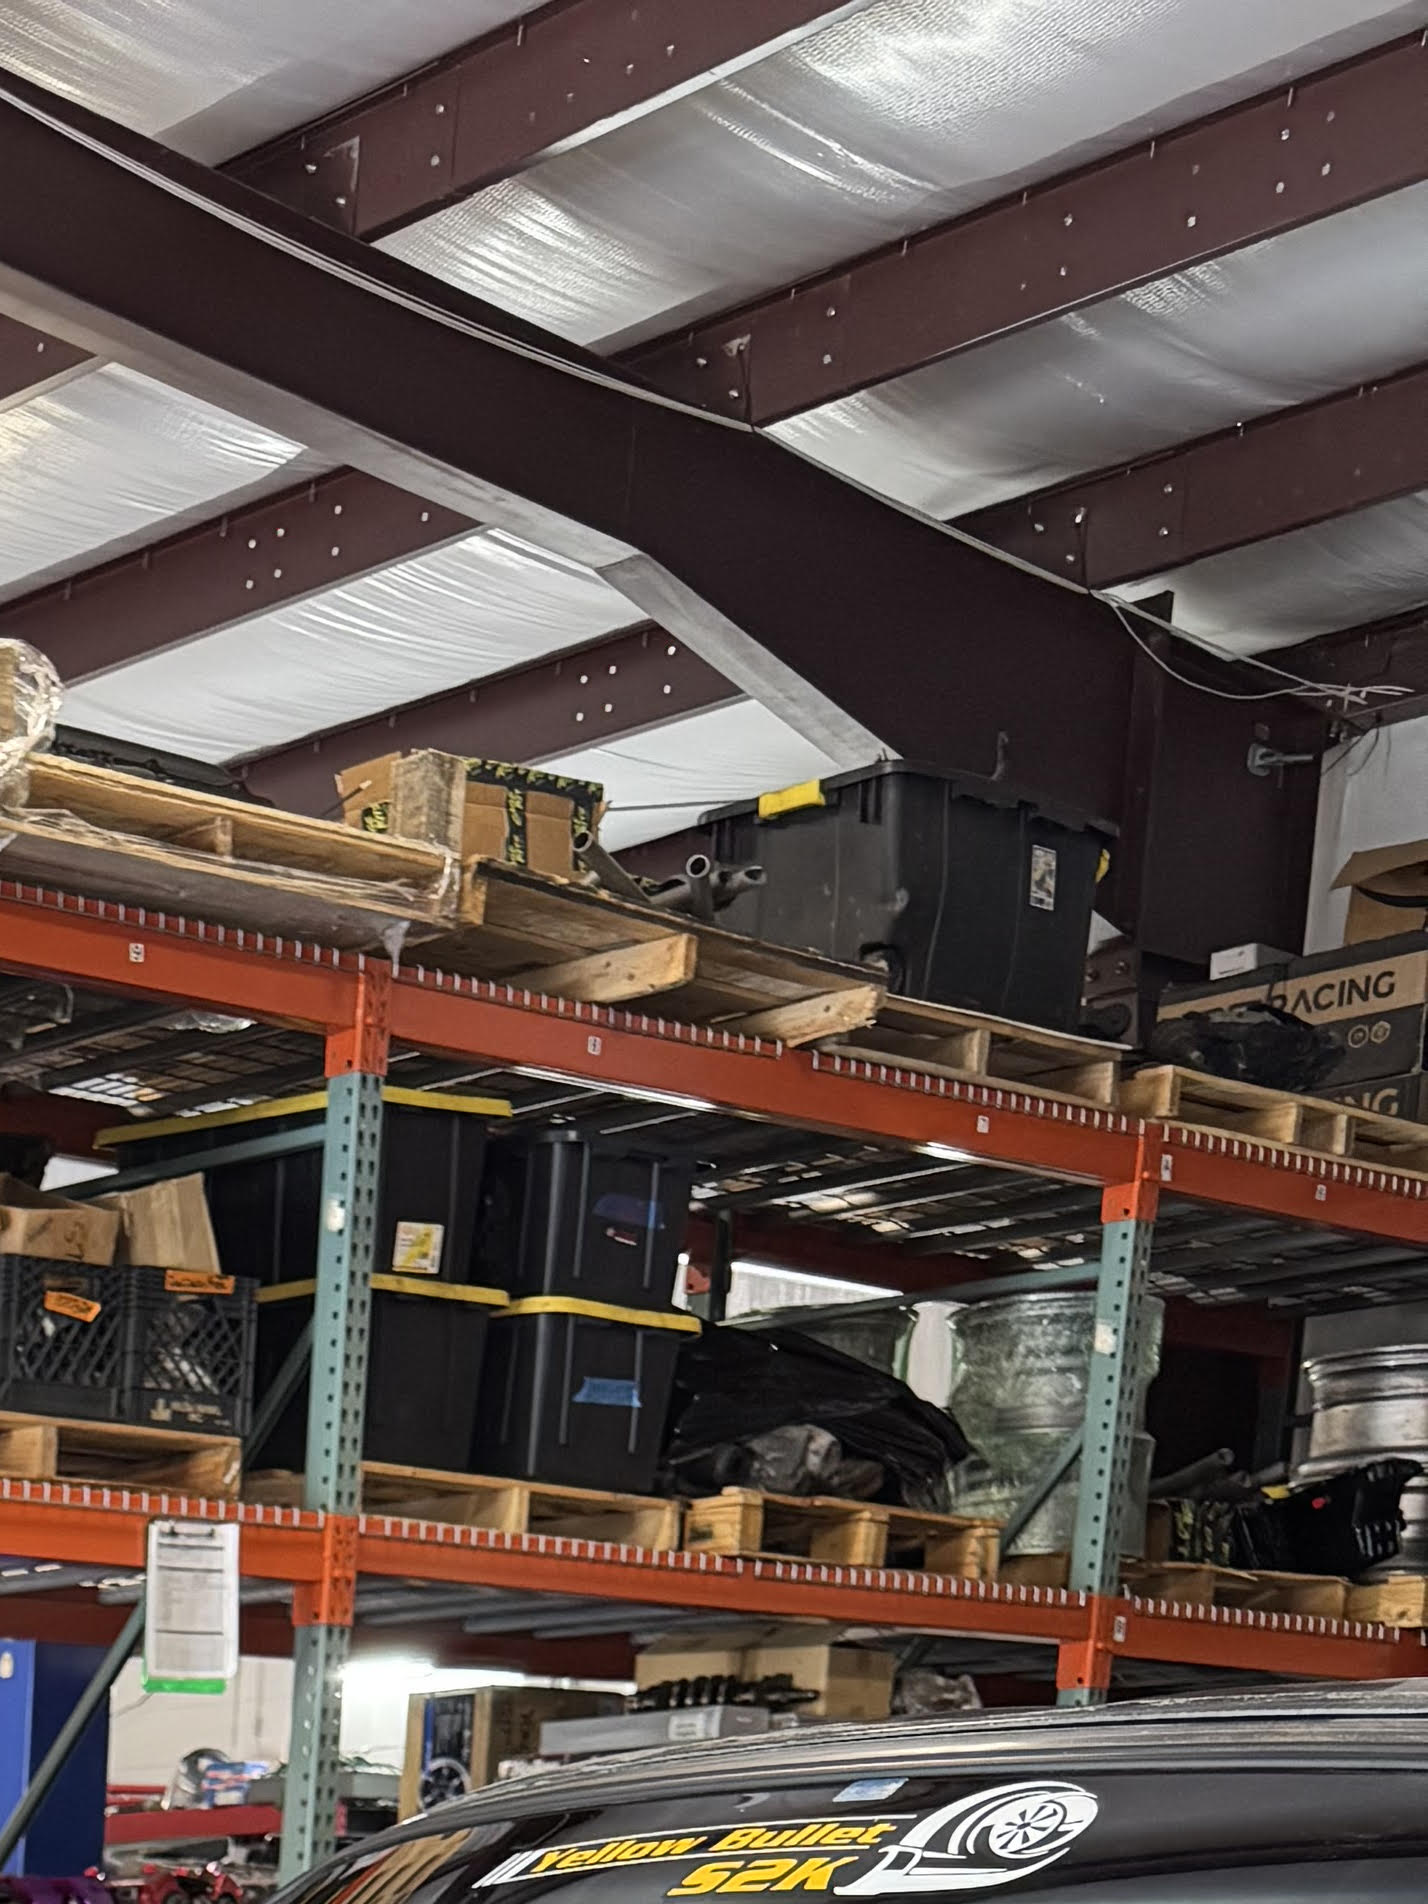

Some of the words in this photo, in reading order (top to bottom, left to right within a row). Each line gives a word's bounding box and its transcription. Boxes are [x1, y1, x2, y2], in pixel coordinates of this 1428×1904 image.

[531, 1836, 710, 1874] Yellow
[711, 1820, 899, 1854] Bullet
[667, 1856, 860, 1898] S2K
